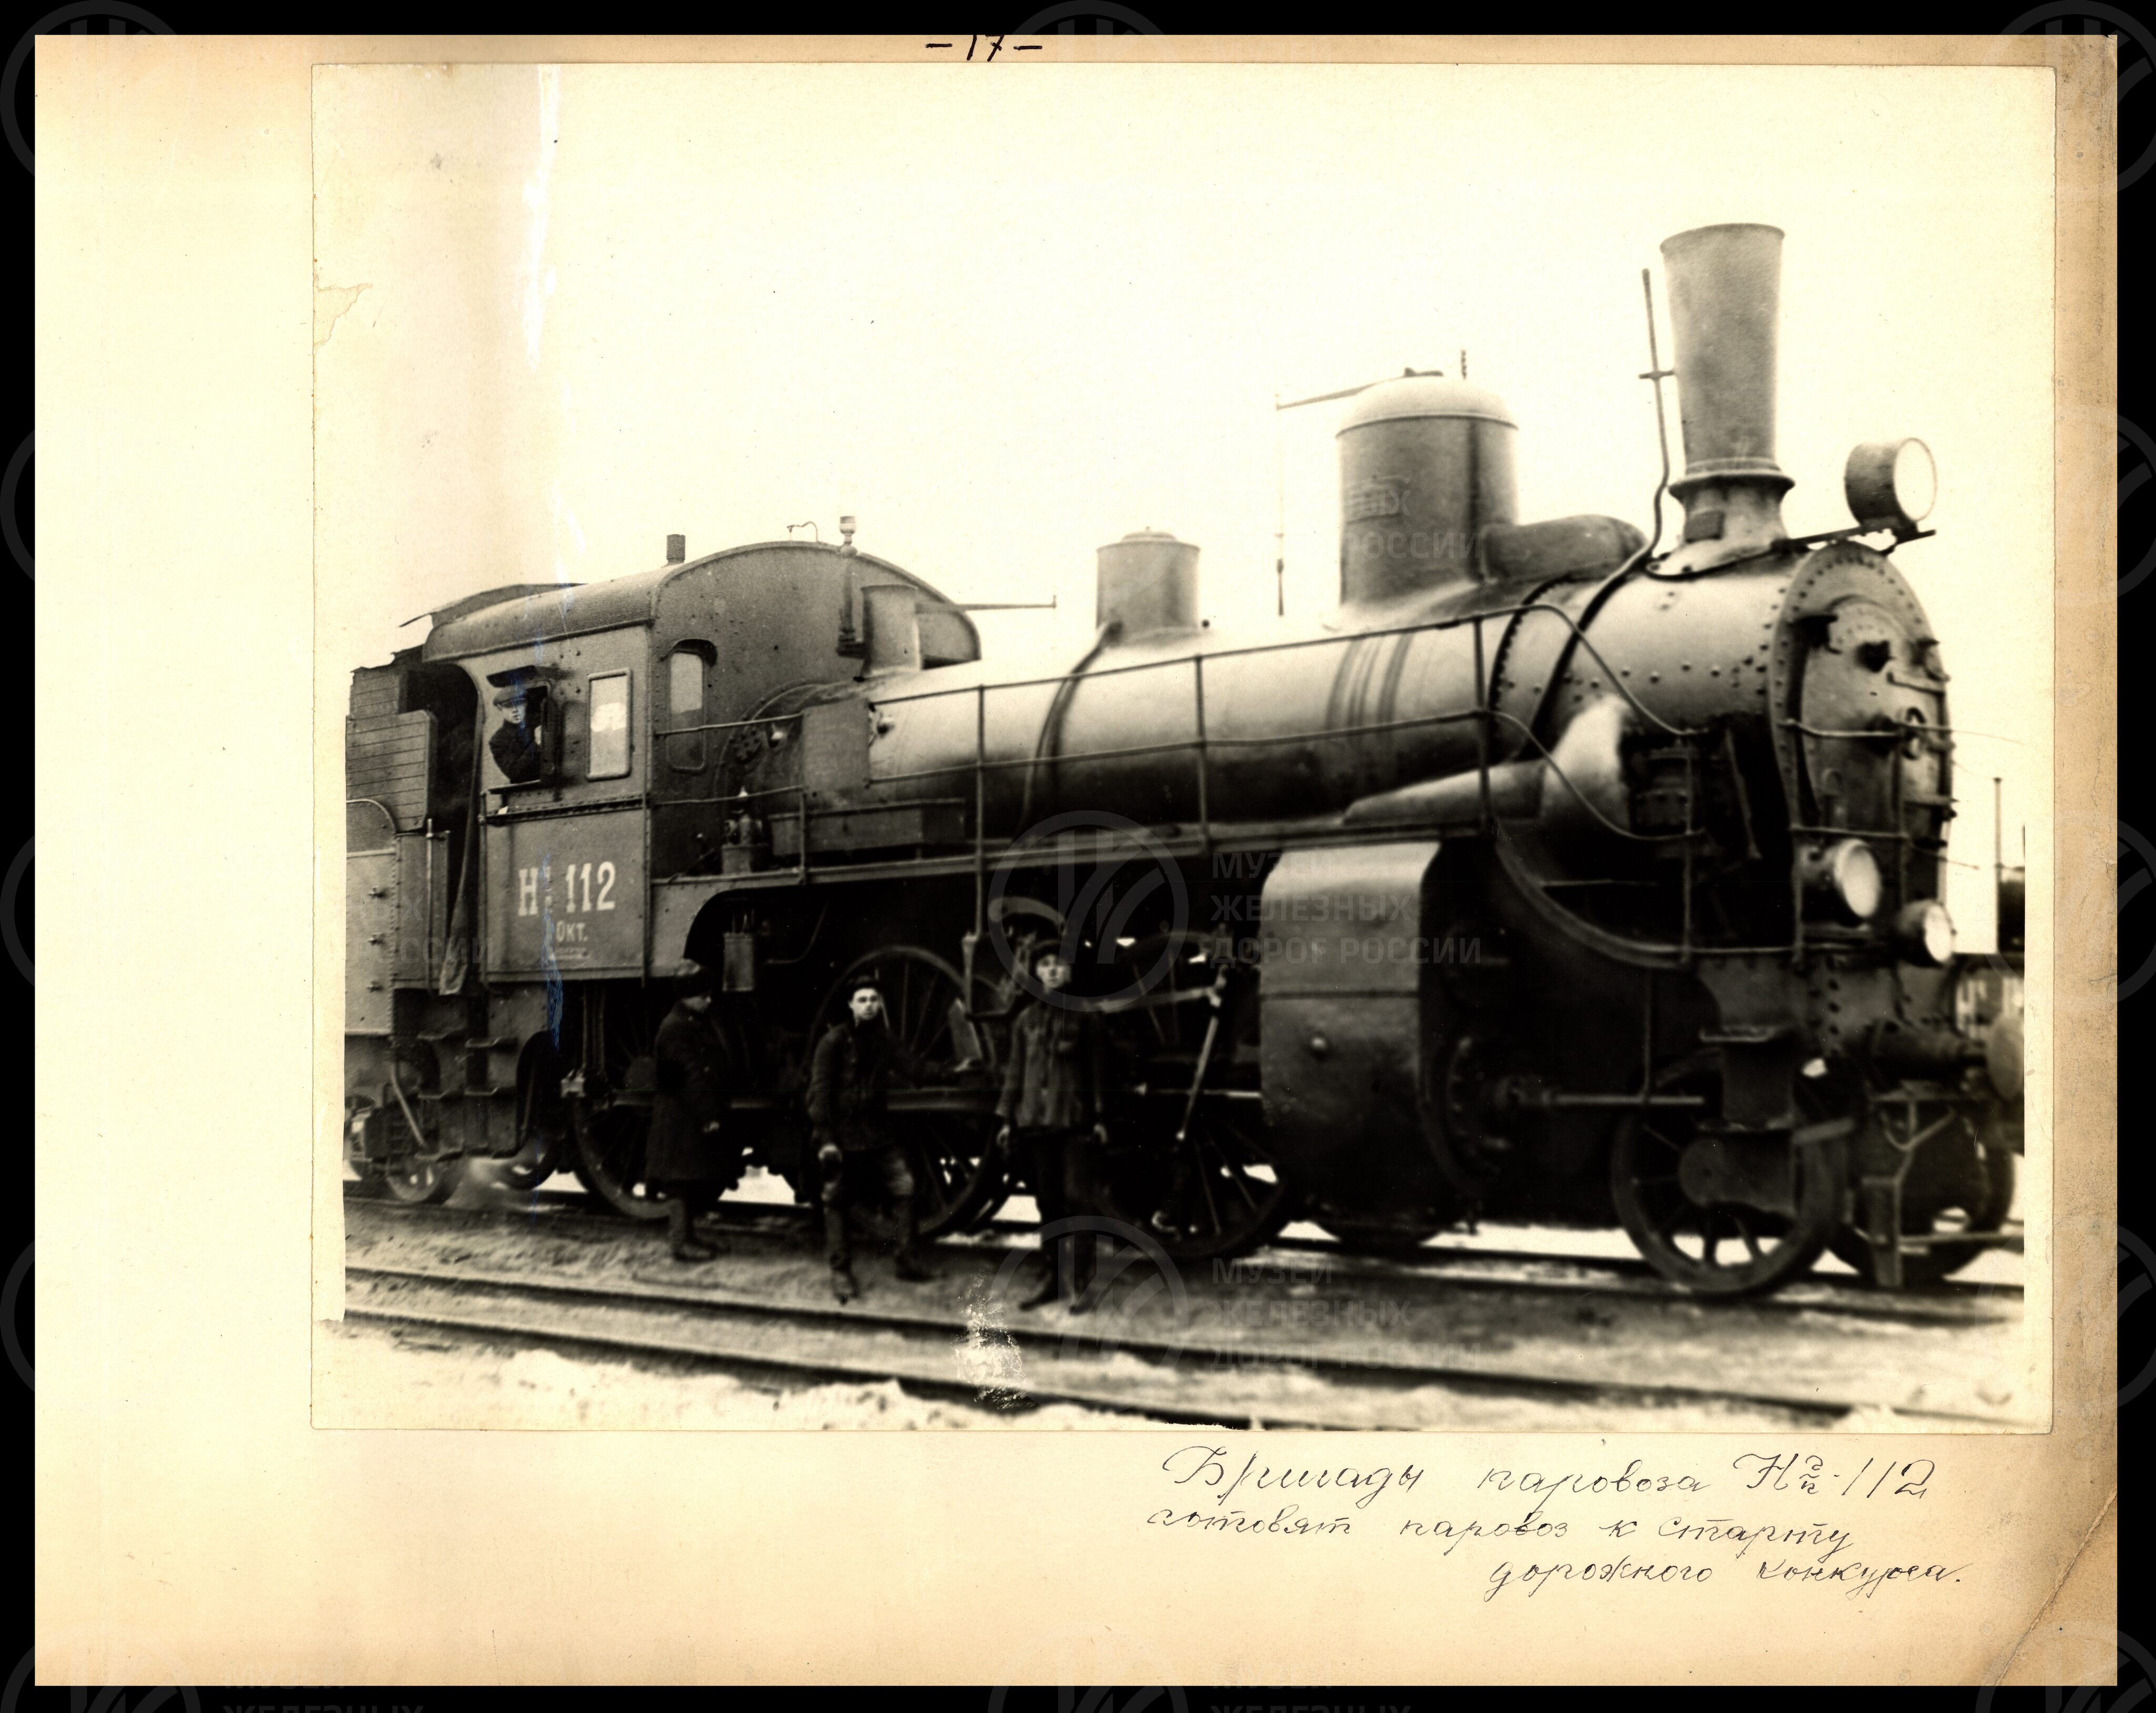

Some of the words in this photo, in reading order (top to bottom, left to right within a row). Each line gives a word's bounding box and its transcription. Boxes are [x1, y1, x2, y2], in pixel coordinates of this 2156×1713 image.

[565, 861, 616, 914] 112
[1162, 1445, 1424, 1510] Бригады
[1476, 1459, 1711, 1513] паровоза
[1146, 1504, 1351, 1535] готовят
[1400, 1510, 1569, 1556] паровоз
[1599, 1519, 1638, 1538] к
[1658, 1516, 1854, 1564] старту
[1483, 1555, 1713, 1603] дорожного
